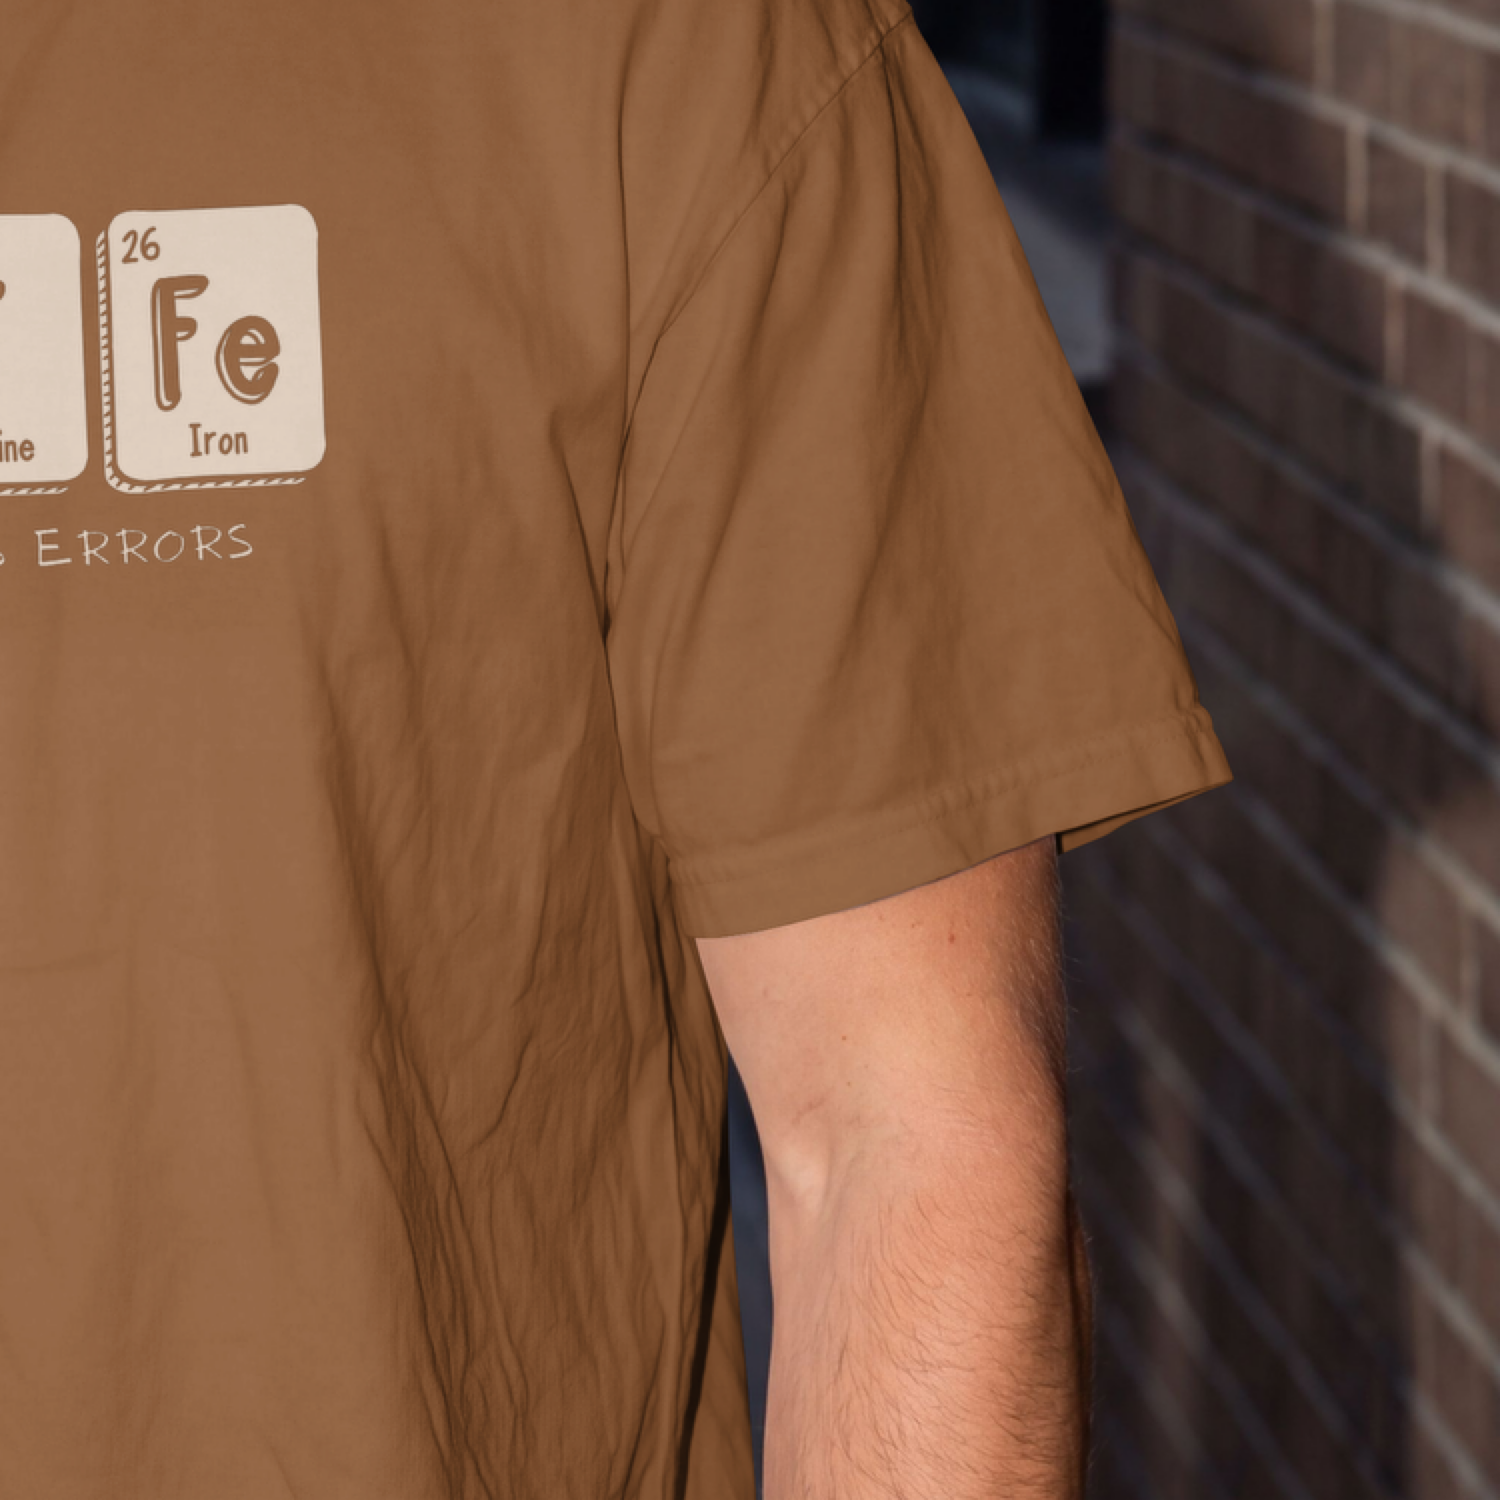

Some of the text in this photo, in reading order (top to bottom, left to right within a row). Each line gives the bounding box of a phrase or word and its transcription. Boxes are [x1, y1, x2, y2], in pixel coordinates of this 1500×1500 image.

[121, 226, 161, 265] 26
[150, 274, 282, 412] Fe
[188, 423, 250, 457] Iron
[34, 523, 254, 568] ERRORS
